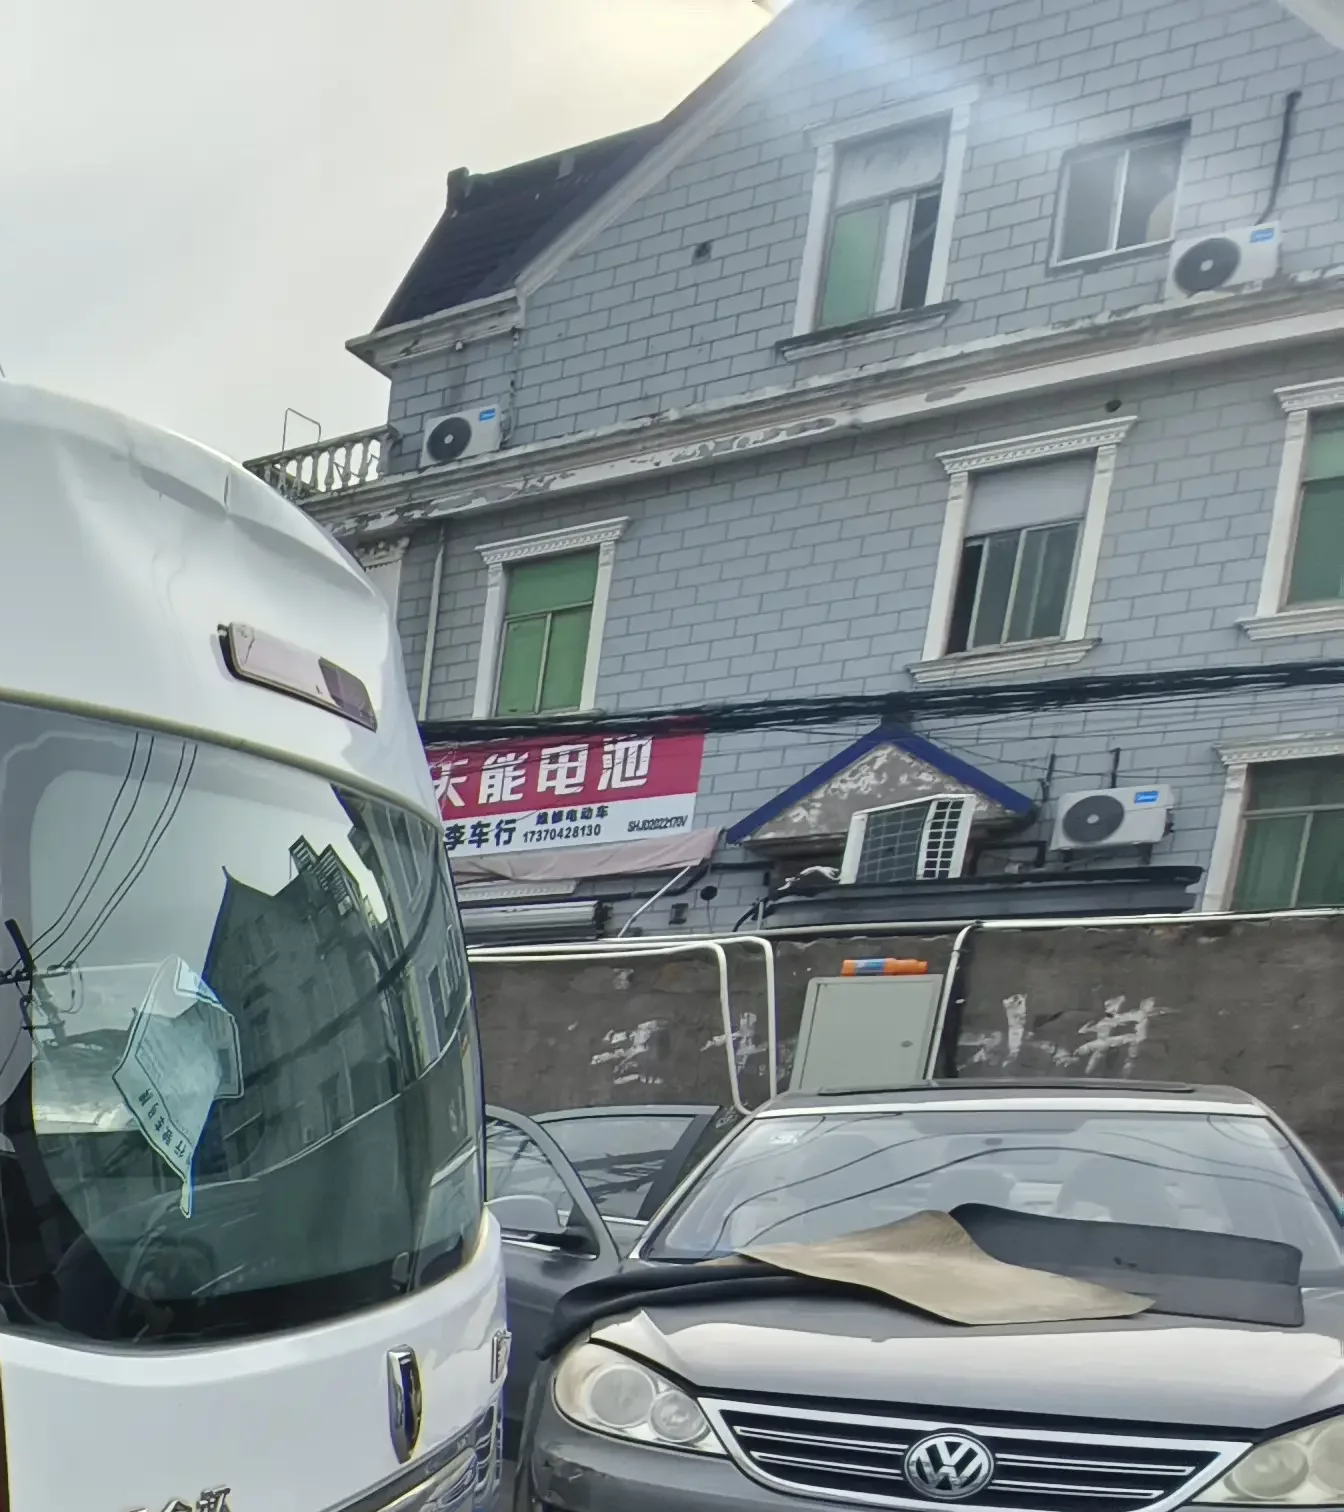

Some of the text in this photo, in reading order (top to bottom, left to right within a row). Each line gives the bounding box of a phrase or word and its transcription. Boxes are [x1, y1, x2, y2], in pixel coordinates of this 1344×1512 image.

[430, 736, 653, 807] 天能电池
[443, 819, 516, 850] 李车行
[523, 823, 602, 843] 17370428130
